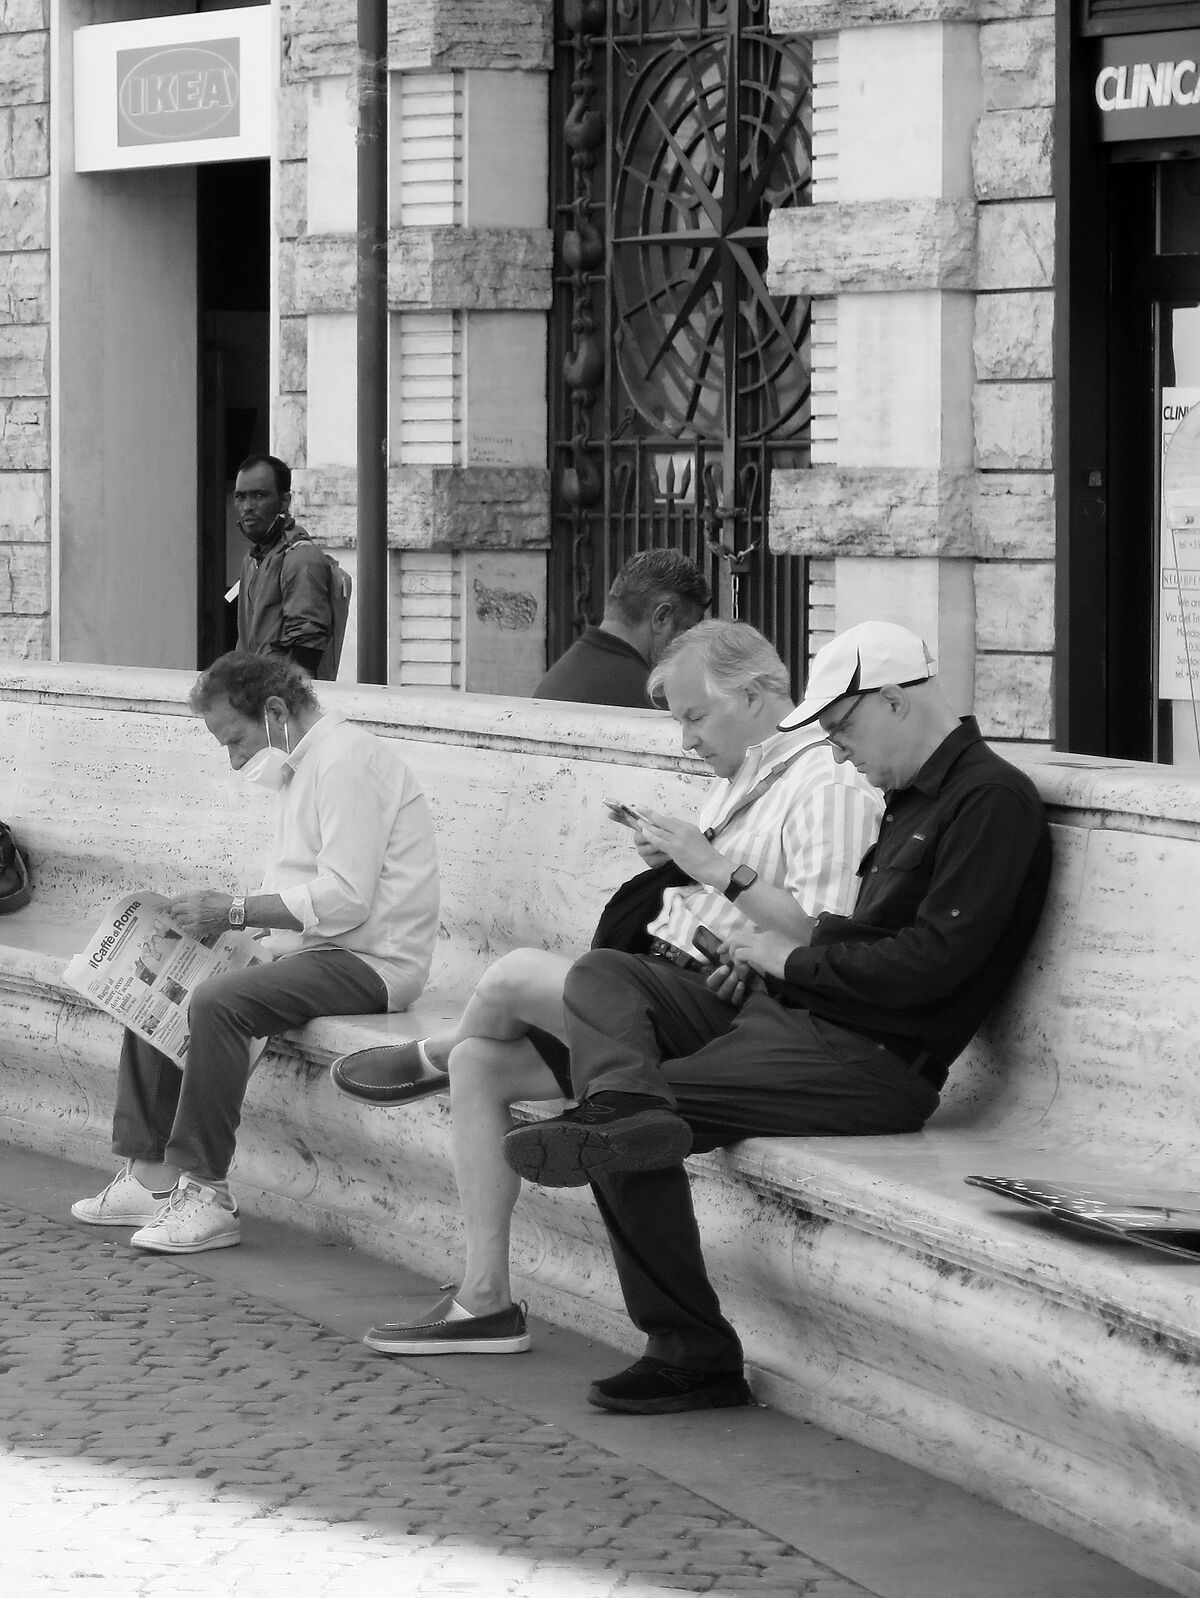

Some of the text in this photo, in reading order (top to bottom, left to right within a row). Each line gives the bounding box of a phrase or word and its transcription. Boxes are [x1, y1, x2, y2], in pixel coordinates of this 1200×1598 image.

[129, 68, 233, 117] IKEA
[1095, 59, 1200, 112] CLINIC
[114, 900, 141, 932] Roma
[112, 926, 119, 938] di
[92, 934, 116, 963] Caffè
[89, 958, 98, 970] il
